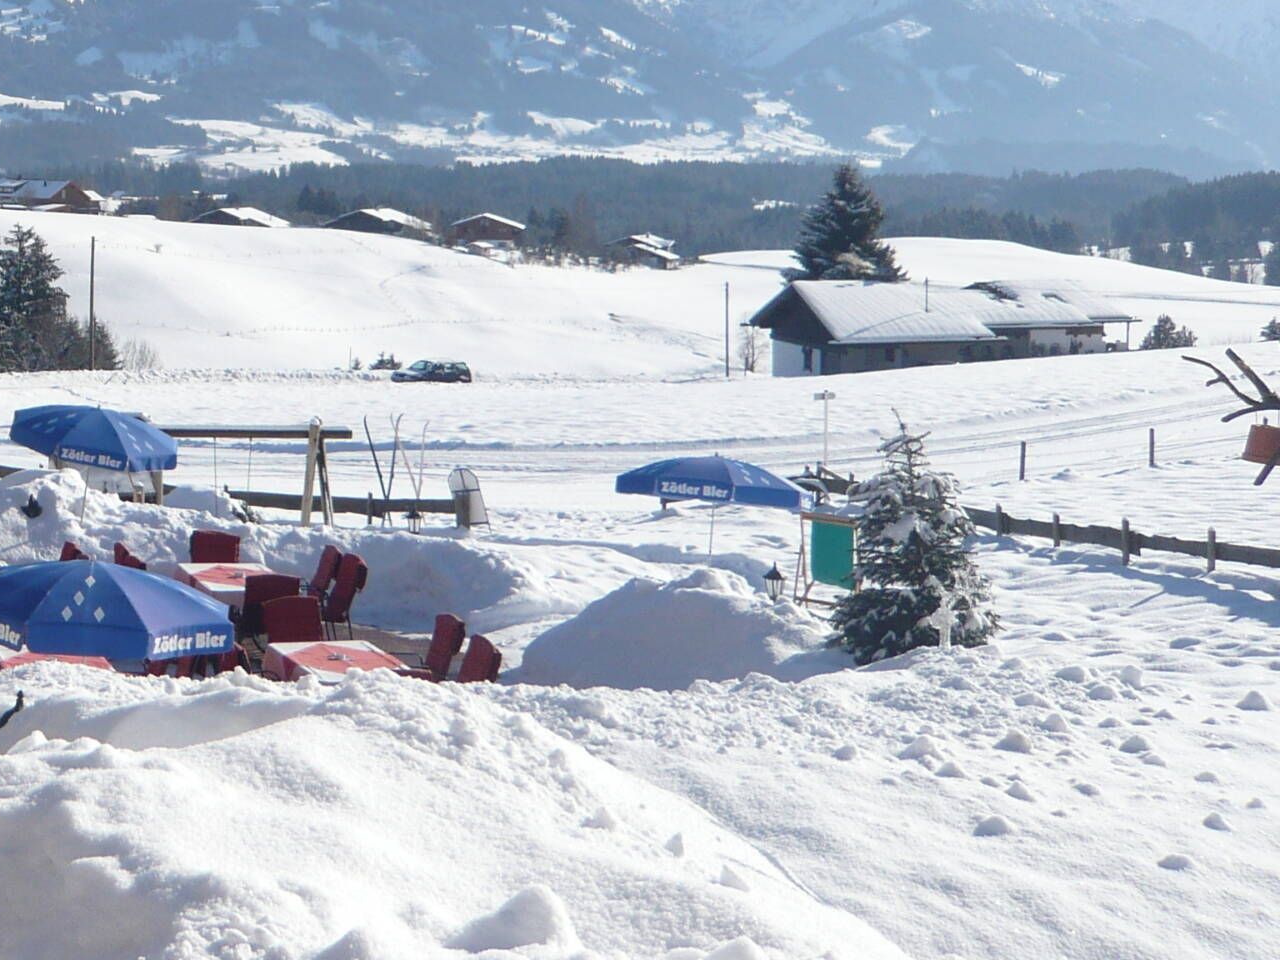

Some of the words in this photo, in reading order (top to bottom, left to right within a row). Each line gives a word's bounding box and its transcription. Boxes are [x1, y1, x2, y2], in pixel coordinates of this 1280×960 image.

[61, 447, 96, 463] Zötler
[98, 454, 122, 468] Bier
[661, 481, 700, 495] Zötler
[702, 485, 728, 498] Bier
[152, 634, 193, 654] Zötler
[195, 631, 227, 648] Bier
